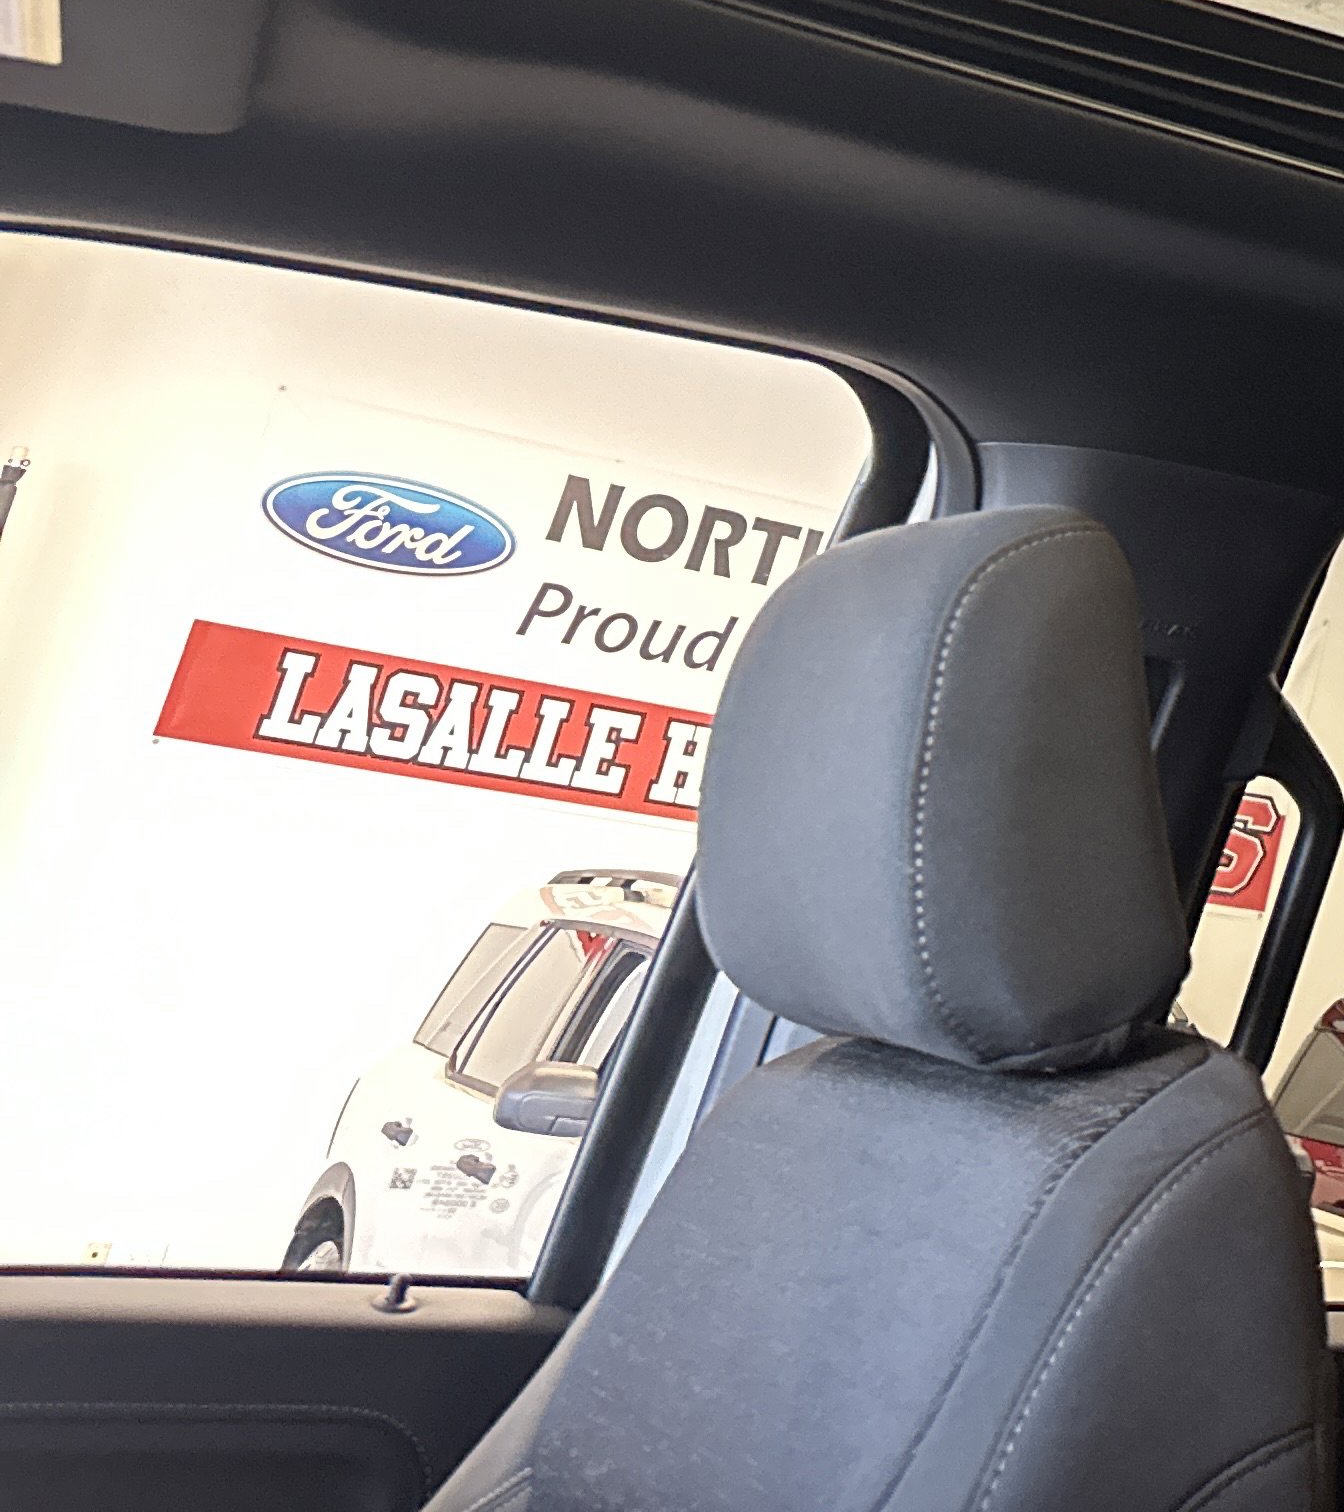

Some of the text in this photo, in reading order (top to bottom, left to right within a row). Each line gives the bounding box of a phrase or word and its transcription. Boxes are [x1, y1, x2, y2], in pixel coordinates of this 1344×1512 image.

[305, 484, 475, 565] Ford
[516, 582, 738, 672] Proud
[253, 646, 648, 798] LASALLE
